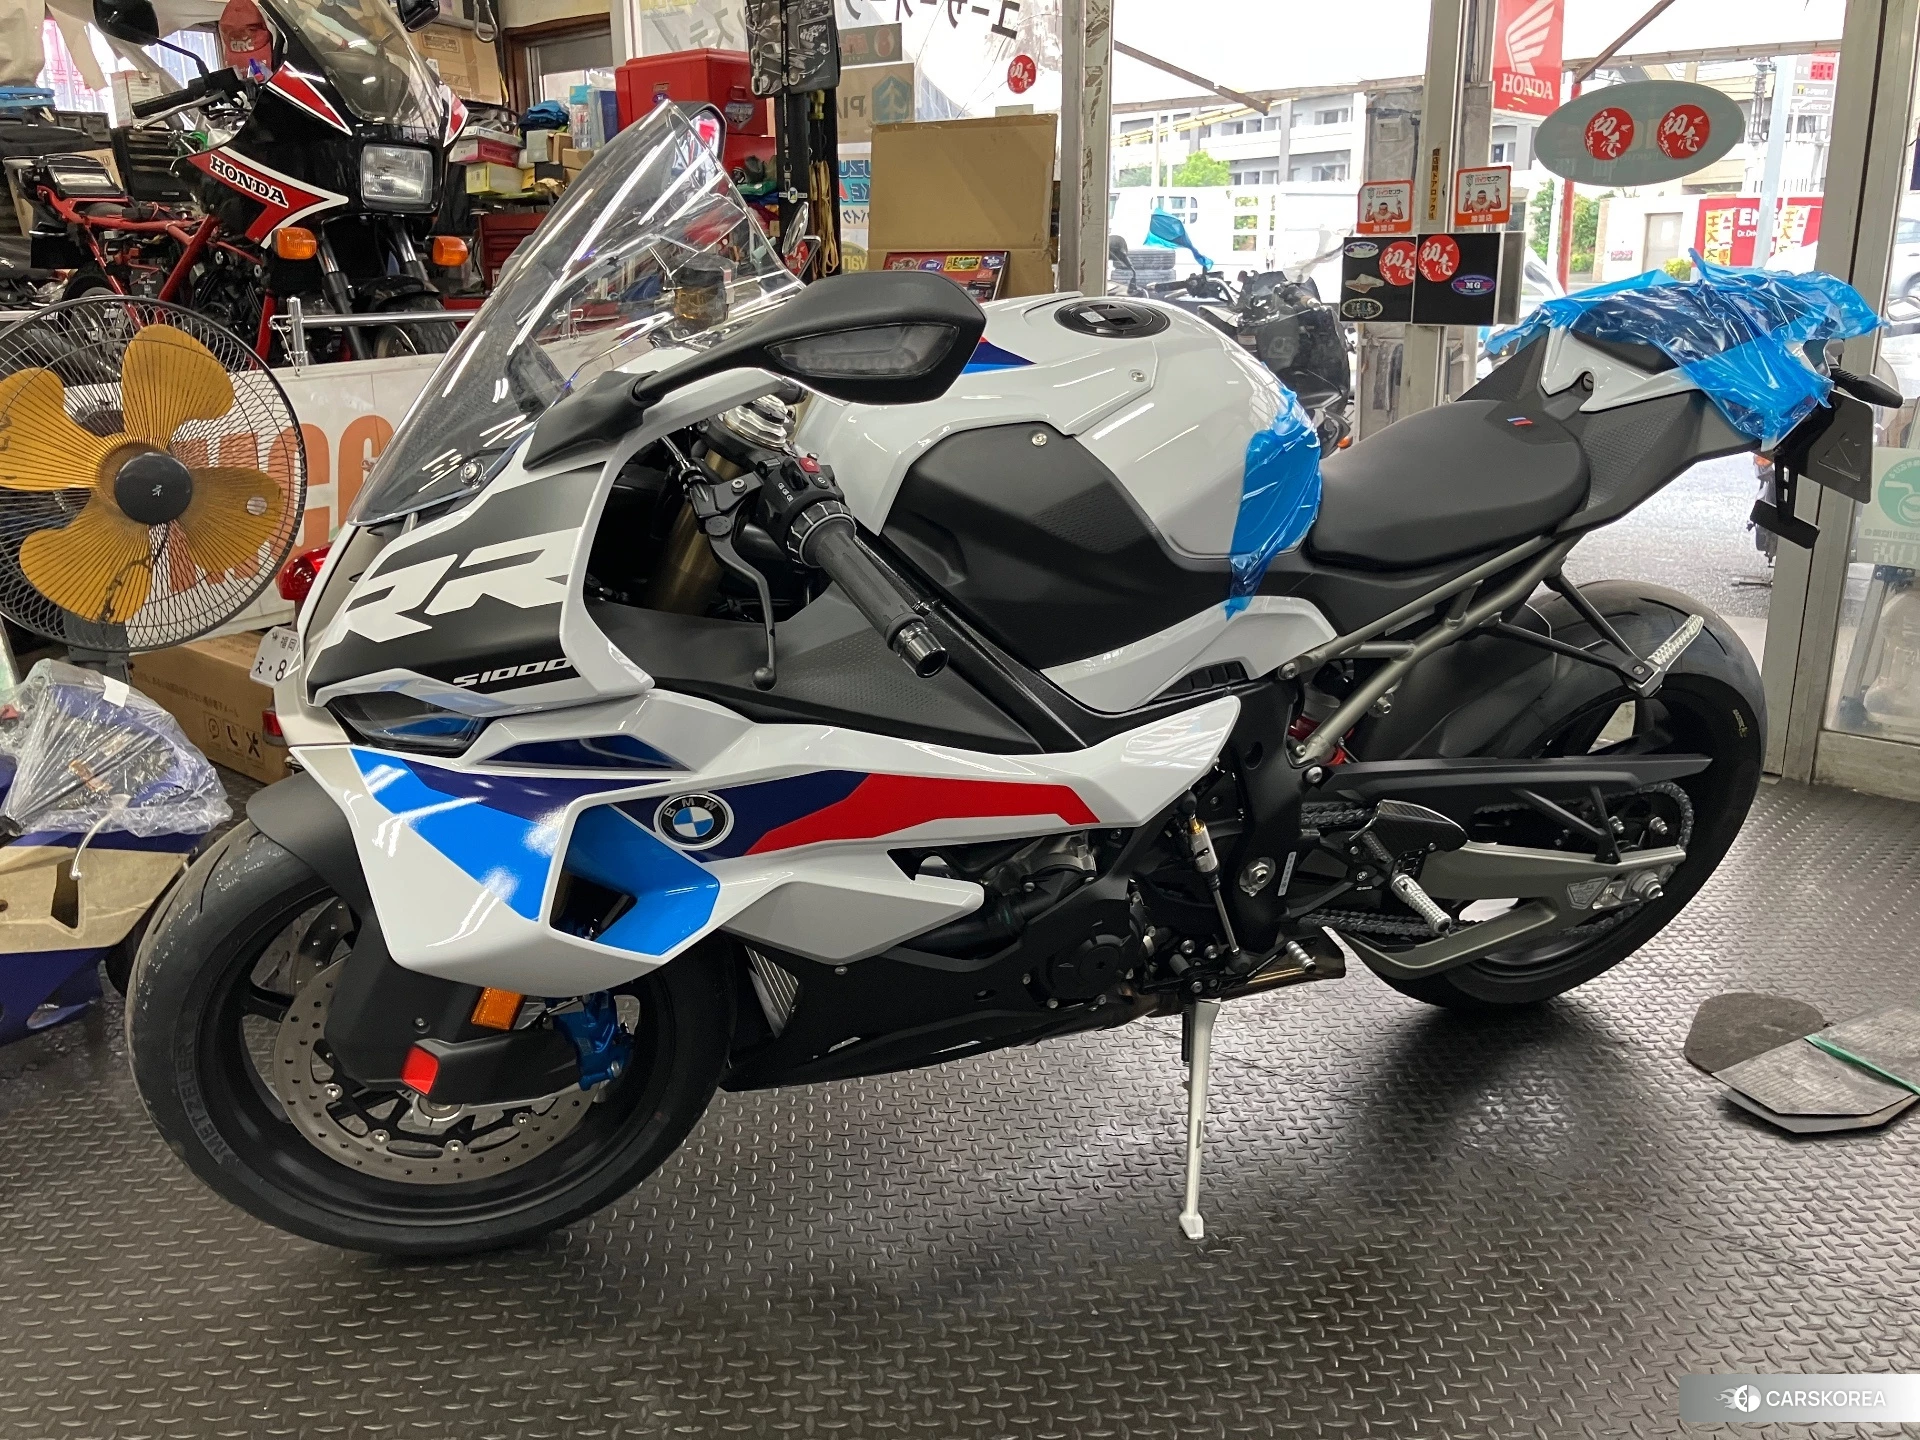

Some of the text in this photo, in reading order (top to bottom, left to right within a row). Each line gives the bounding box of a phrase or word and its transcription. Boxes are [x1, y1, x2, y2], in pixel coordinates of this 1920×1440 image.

[1501, 73, 1554, 100] HONDA
[210, 154, 289, 209] HONDA
[321, 527, 582, 651] RR
[453, 657, 574, 688] S1000
[664, 797, 718, 817] BMW
